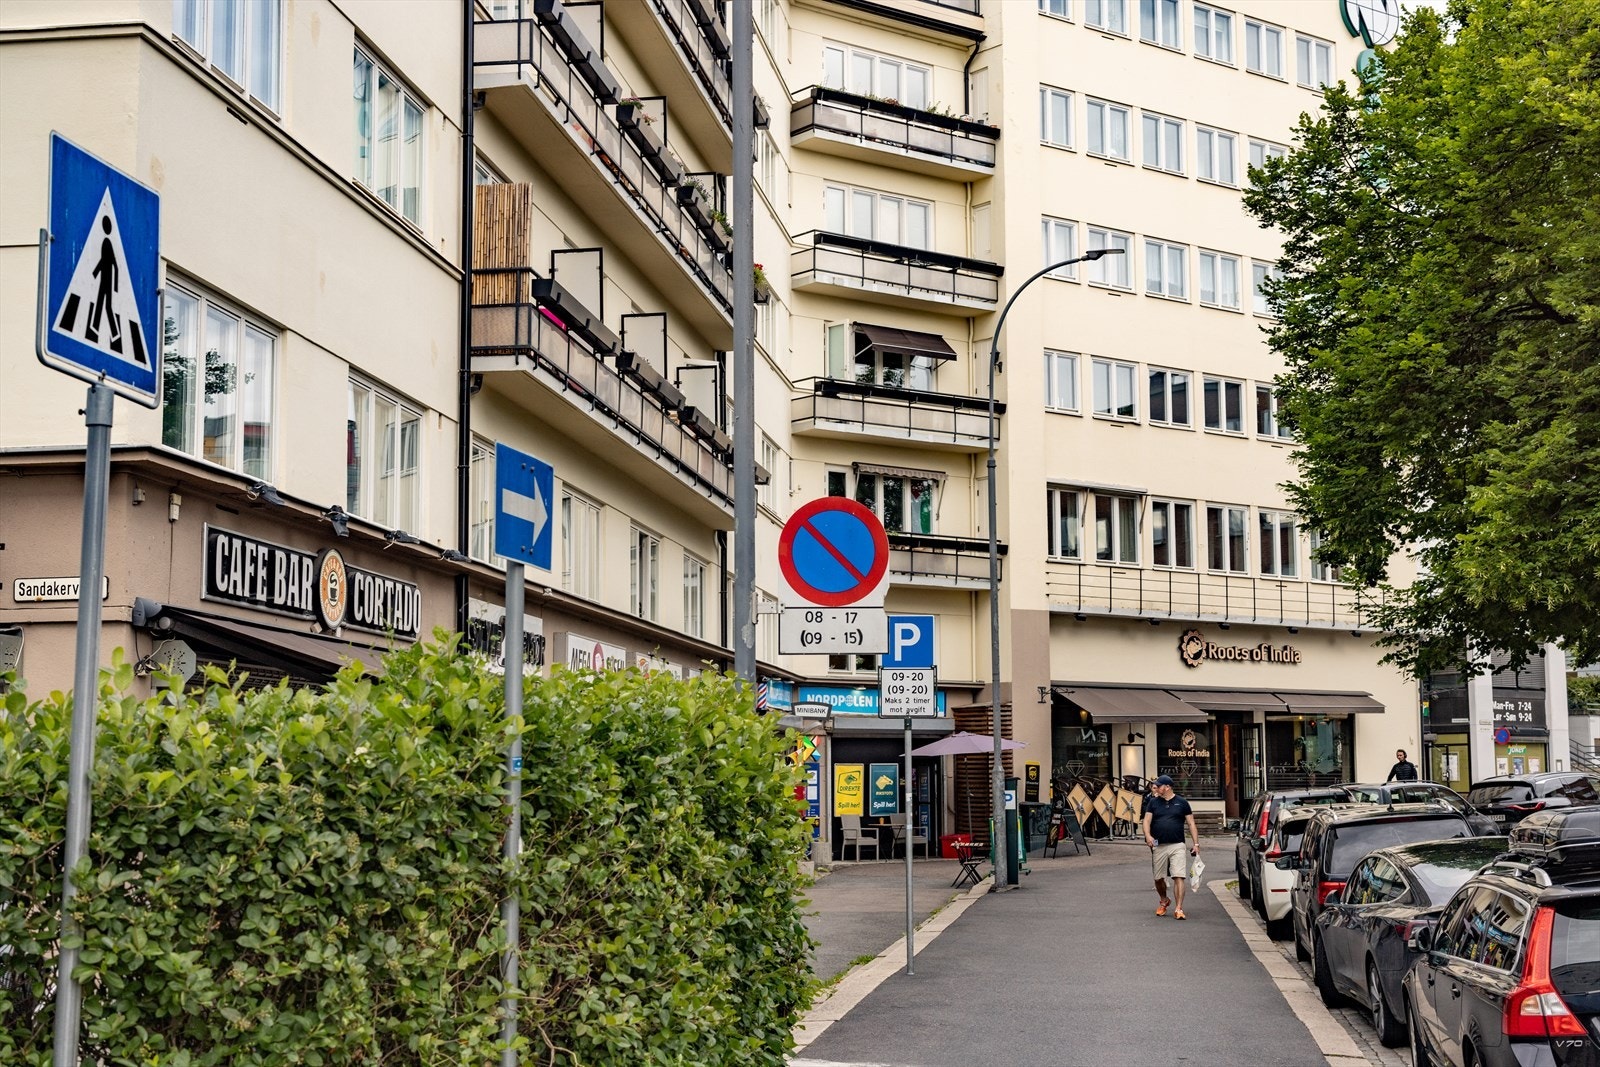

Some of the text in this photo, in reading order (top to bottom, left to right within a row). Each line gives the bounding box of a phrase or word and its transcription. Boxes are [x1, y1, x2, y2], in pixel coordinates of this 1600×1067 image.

[18, 581, 80, 596] Sandakerv
[215, 534, 269, 602] CAFE
[274, 549, 314, 611] BAR
[353, 571, 422, 634] CORTADO
[805, 611, 823, 623] 08
[845, 612, 858, 624] 17
[800, 629, 822, 647] (09
[844, 628, 863, 646] 15)
[894, 622, 921, 661] P
[1208, 641, 1302, 663] Roots of India
[807, 694, 873, 707] NORDPOLEN
[906, 706, 926, 714] avgift
[1168, 749, 1210, 758] Roots of India
[873, 801, 885, 809] Spill
[1555, 1039, 1583, 1048] V70
